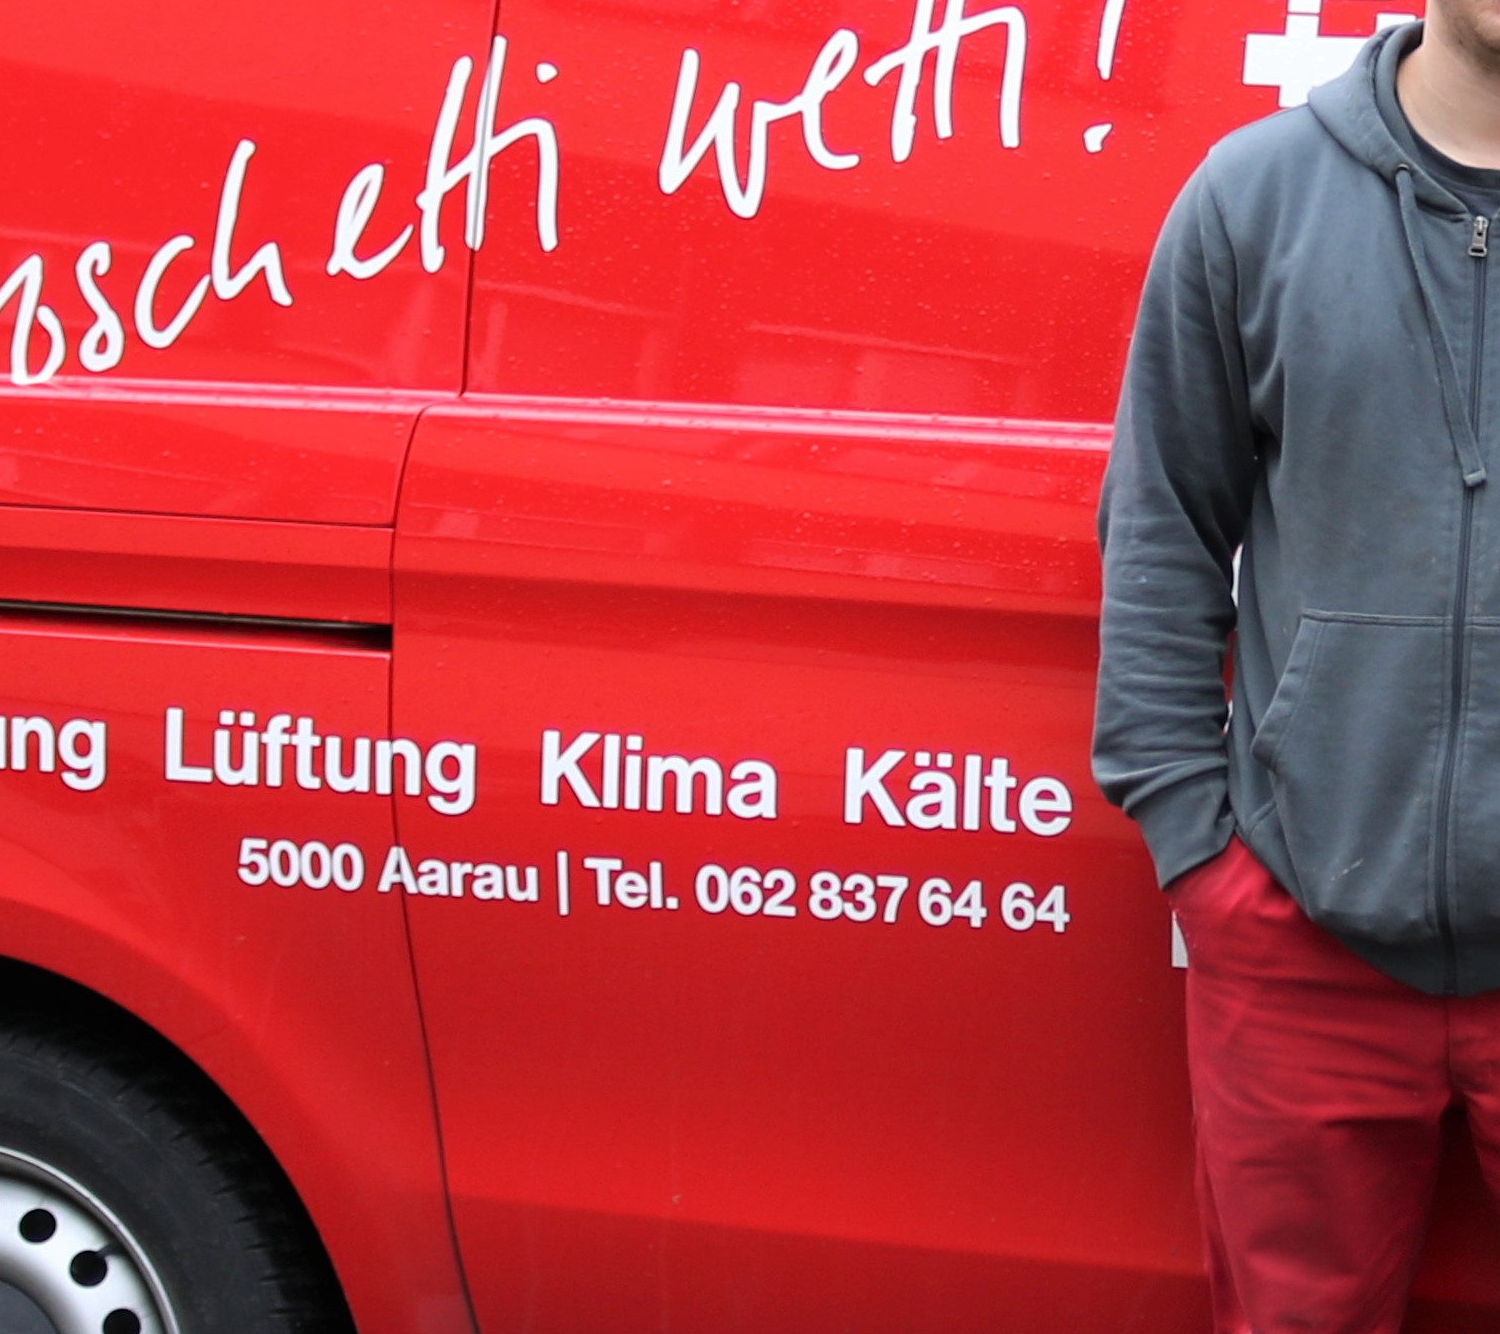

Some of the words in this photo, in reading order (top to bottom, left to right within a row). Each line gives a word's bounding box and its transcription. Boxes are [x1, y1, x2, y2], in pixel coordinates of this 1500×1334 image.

[164, 708, 478, 816] Lüftung
[540, 728, 779, 820] Klima
[843, 746, 1074, 837] Kälte
[236, 836, 366, 892] 5000
[376, 844, 540, 903] Aarau
[582, 856, 681, 911] Tel.
[694, 863, 798, 918] 062
[807, 870, 910, 924] 837
[917, 876, 989, 929] 64
[999, 881, 1072, 934] 64
